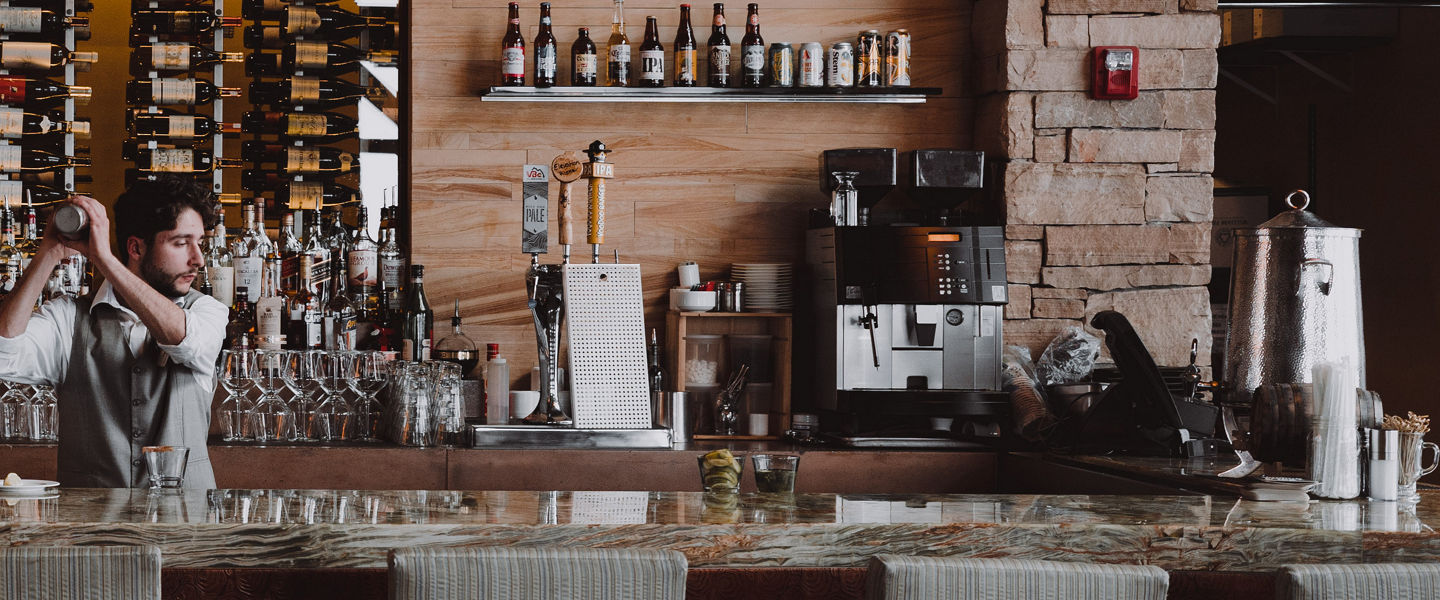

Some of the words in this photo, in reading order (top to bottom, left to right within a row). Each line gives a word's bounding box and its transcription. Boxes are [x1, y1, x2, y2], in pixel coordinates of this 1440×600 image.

[642, 58, 663, 73] IPA
[832, 51, 840, 73] Stem
[596, 164, 612, 176] IPA
[526, 208, 545, 222] PALE
[596, 212, 605, 237] VOODOO
